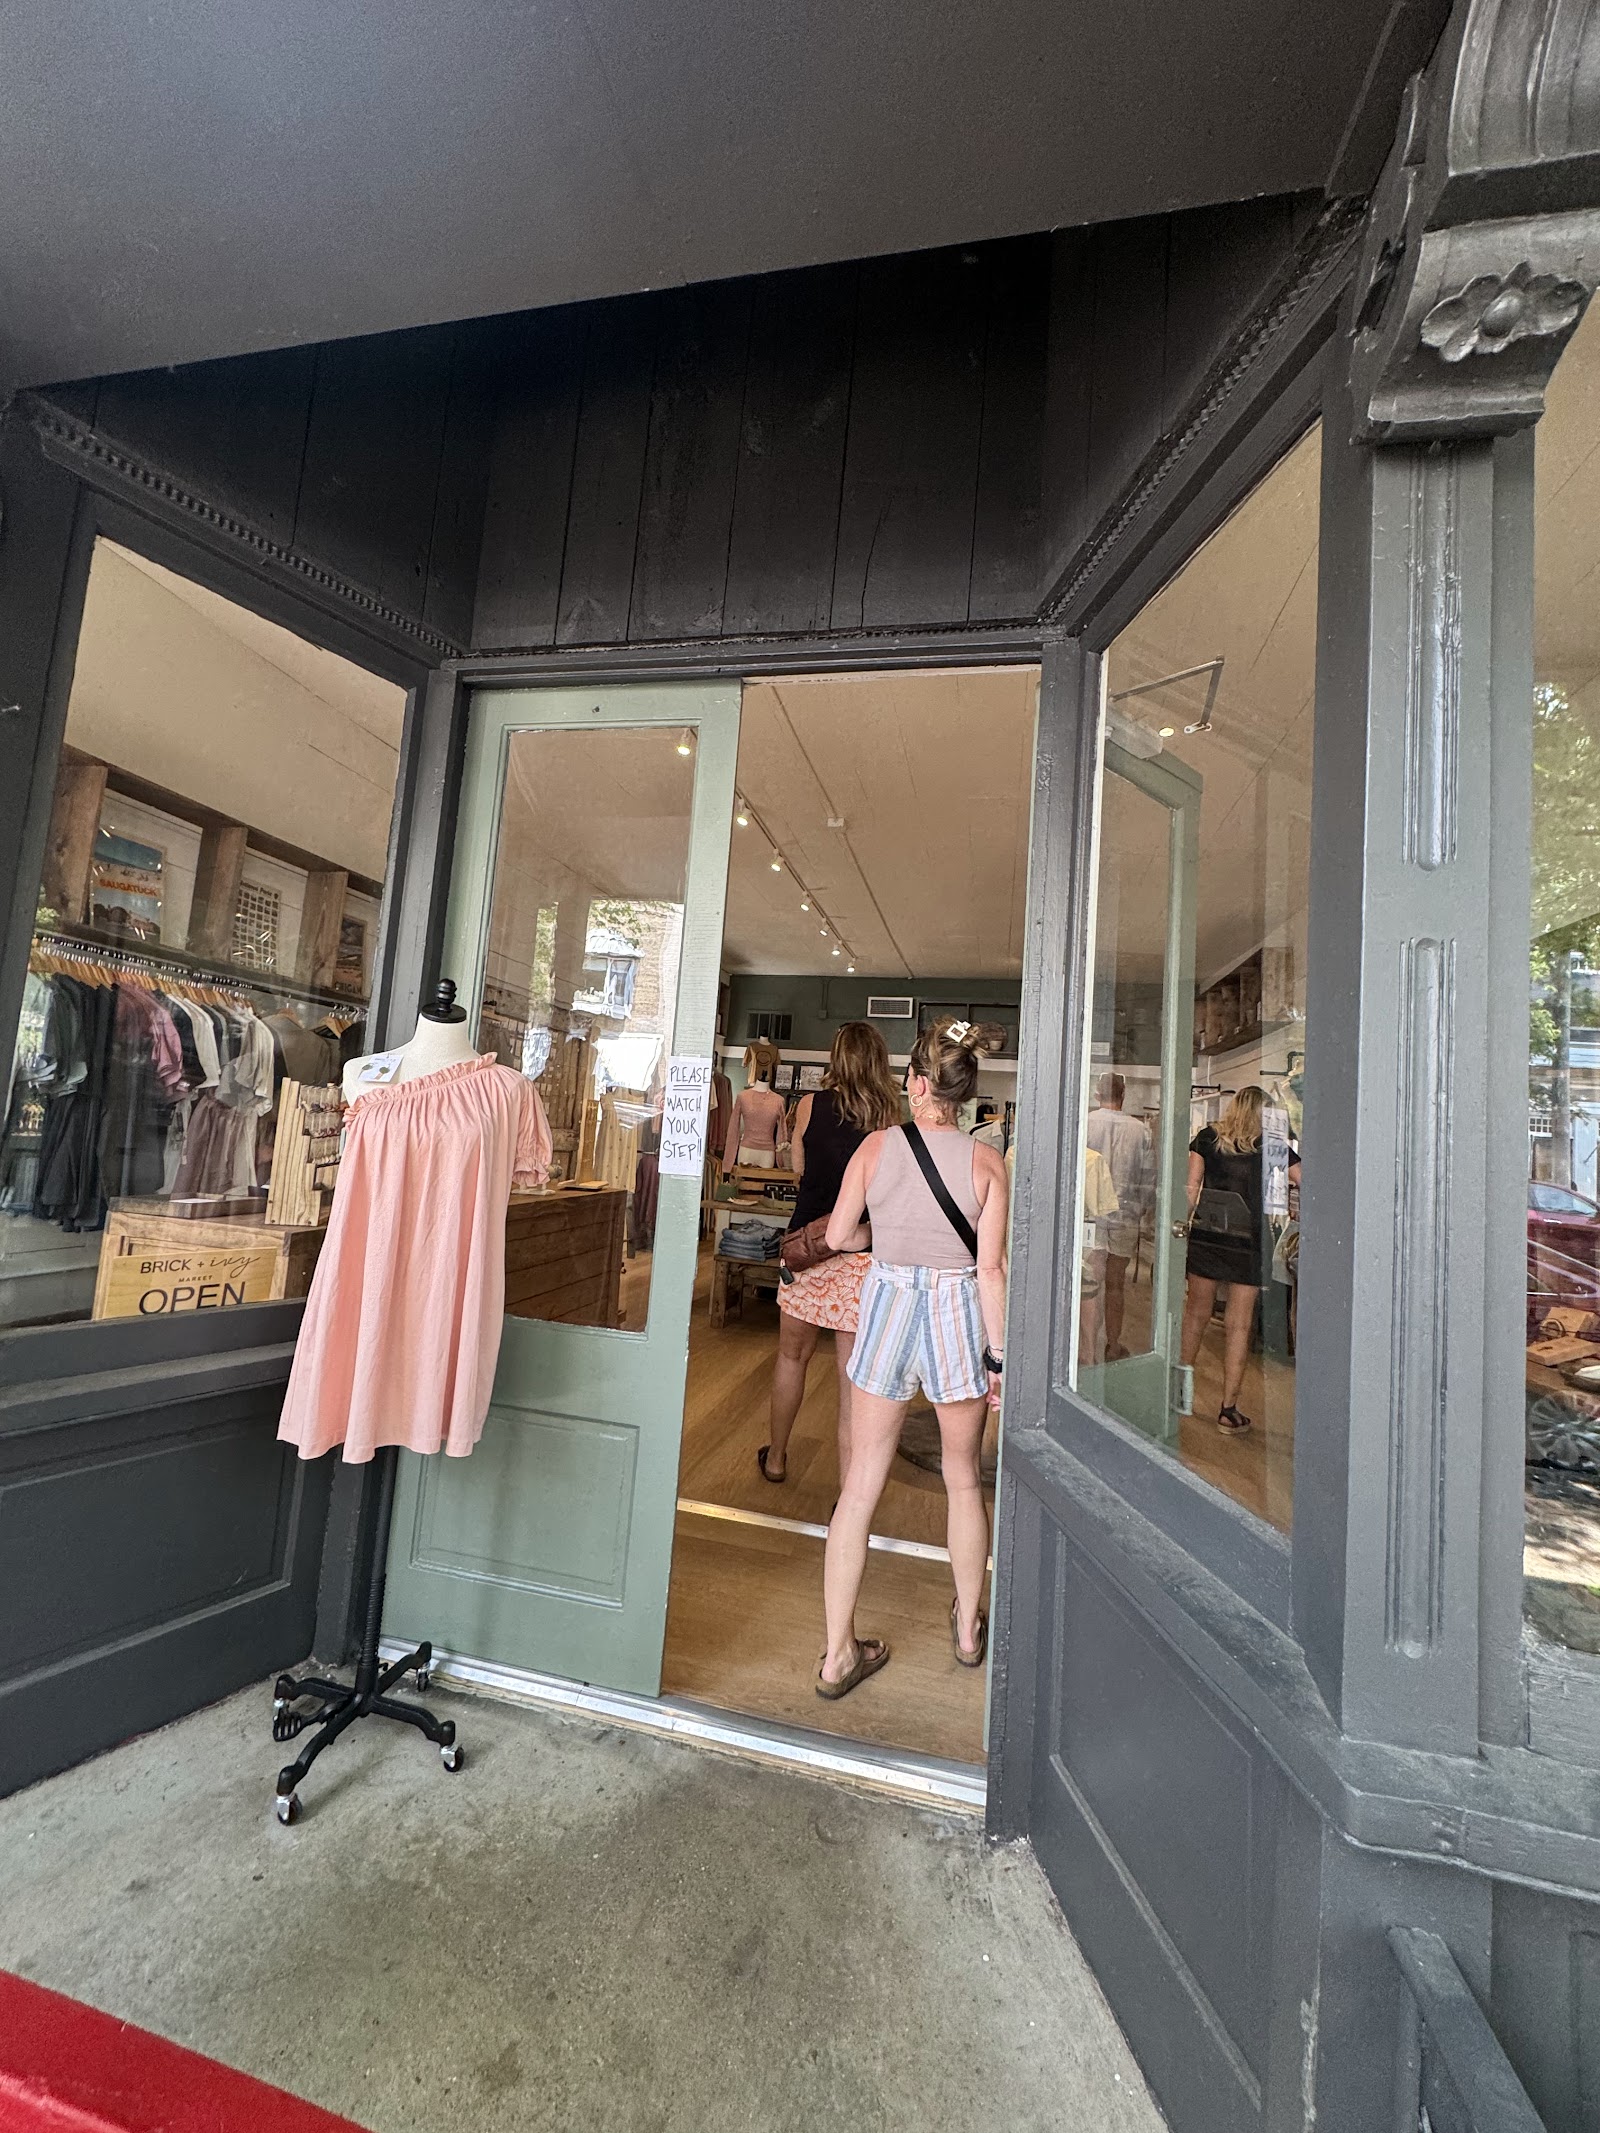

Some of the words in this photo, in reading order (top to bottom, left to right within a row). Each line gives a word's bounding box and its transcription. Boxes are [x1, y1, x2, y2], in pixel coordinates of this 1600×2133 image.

[99, 878, 158, 897] SAUGATUCK
[670, 1065, 711, 1084] PLEASE
[667, 1094, 702, 1112] WATCH
[666, 1116, 700, 1138] YOUR
[140, 1258, 192, 1274] BRICK
[210, 1256, 261, 1278] ivy
[178, 1275, 213, 1283] MARKET
[139, 1281, 246, 1315] OPEN
